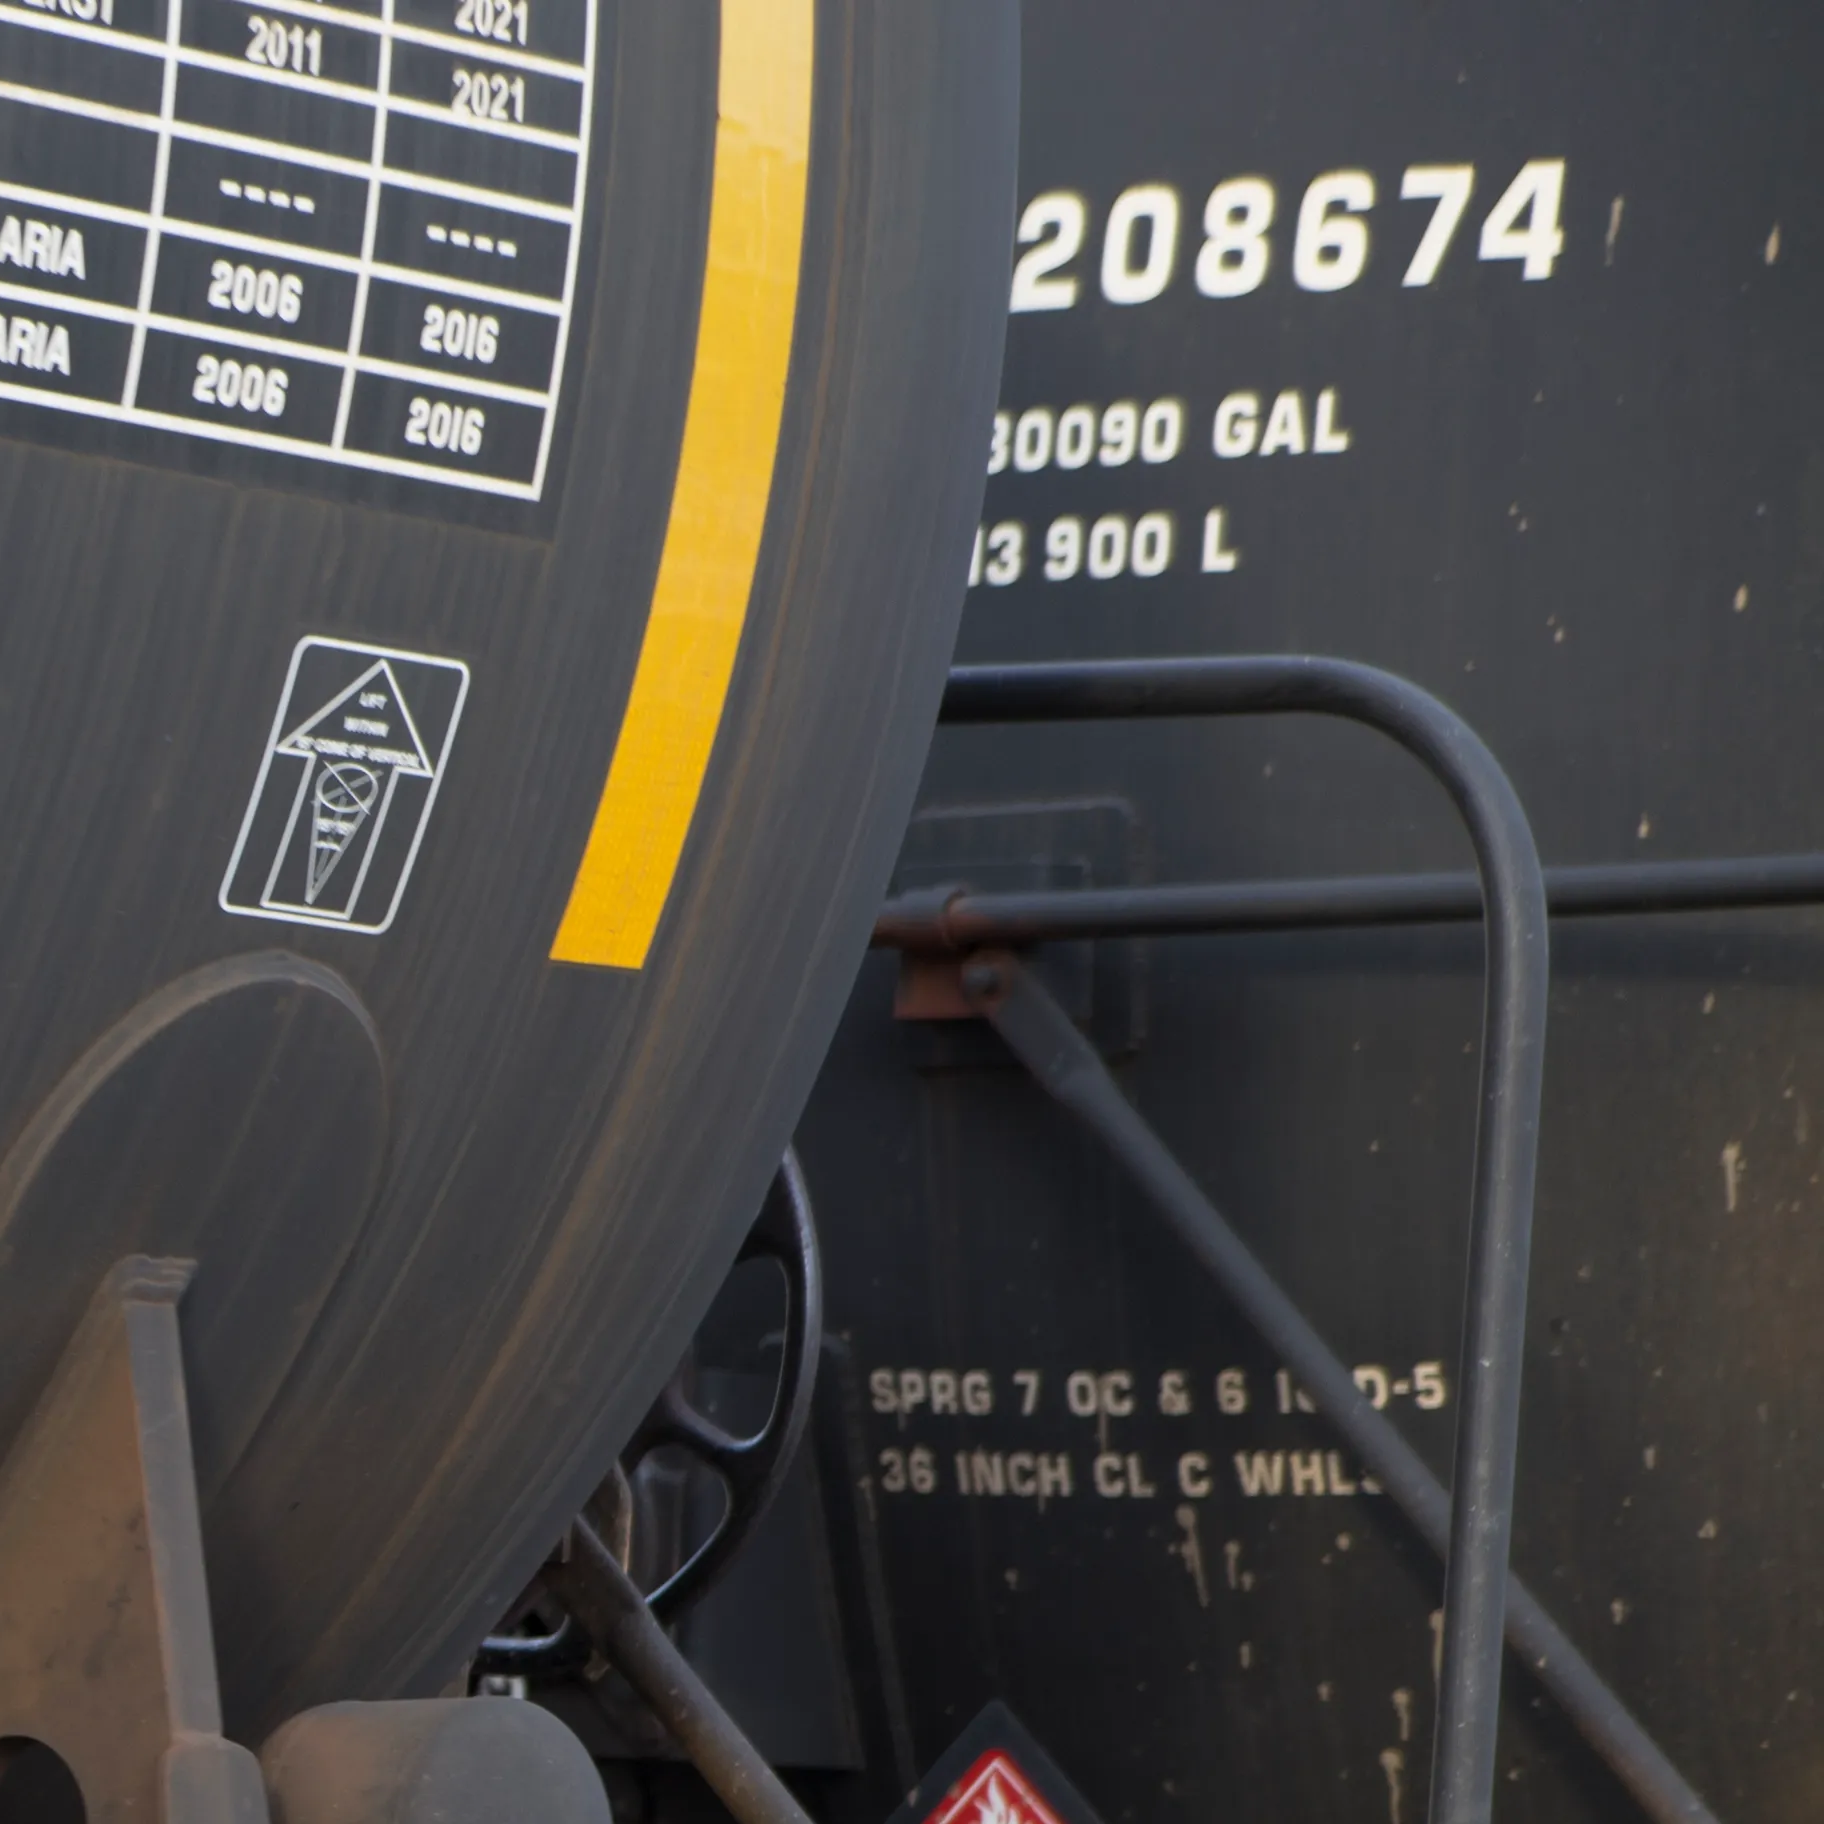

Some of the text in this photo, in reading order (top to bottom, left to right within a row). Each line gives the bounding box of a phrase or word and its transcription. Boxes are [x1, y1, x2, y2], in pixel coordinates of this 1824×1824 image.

[245, 15, 322, 77] 2011
[451, 67, 525, 123] 2021
[1009, 156, 1566, 314] 208674
[207, 259, 303, 323] 2006
[419, 304, 499, 364] 2016
[192, 354, 288, 416] 2006
[404, 397, 485, 456] 2016
[1212, 386, 1349, 459] GAL
[1043, 510, 1172, 582] 900
[1202, 506, 1237, 574] L
[871, 1366, 992, 1416] SPRG
[1012, 1370, 1041, 1416] 7
[1158, 1369, 1192, 1416] &
[1216, 1368, 1246, 1415] 6
[879, 1446, 1384, 1498] 36 INCH CL C WHL
